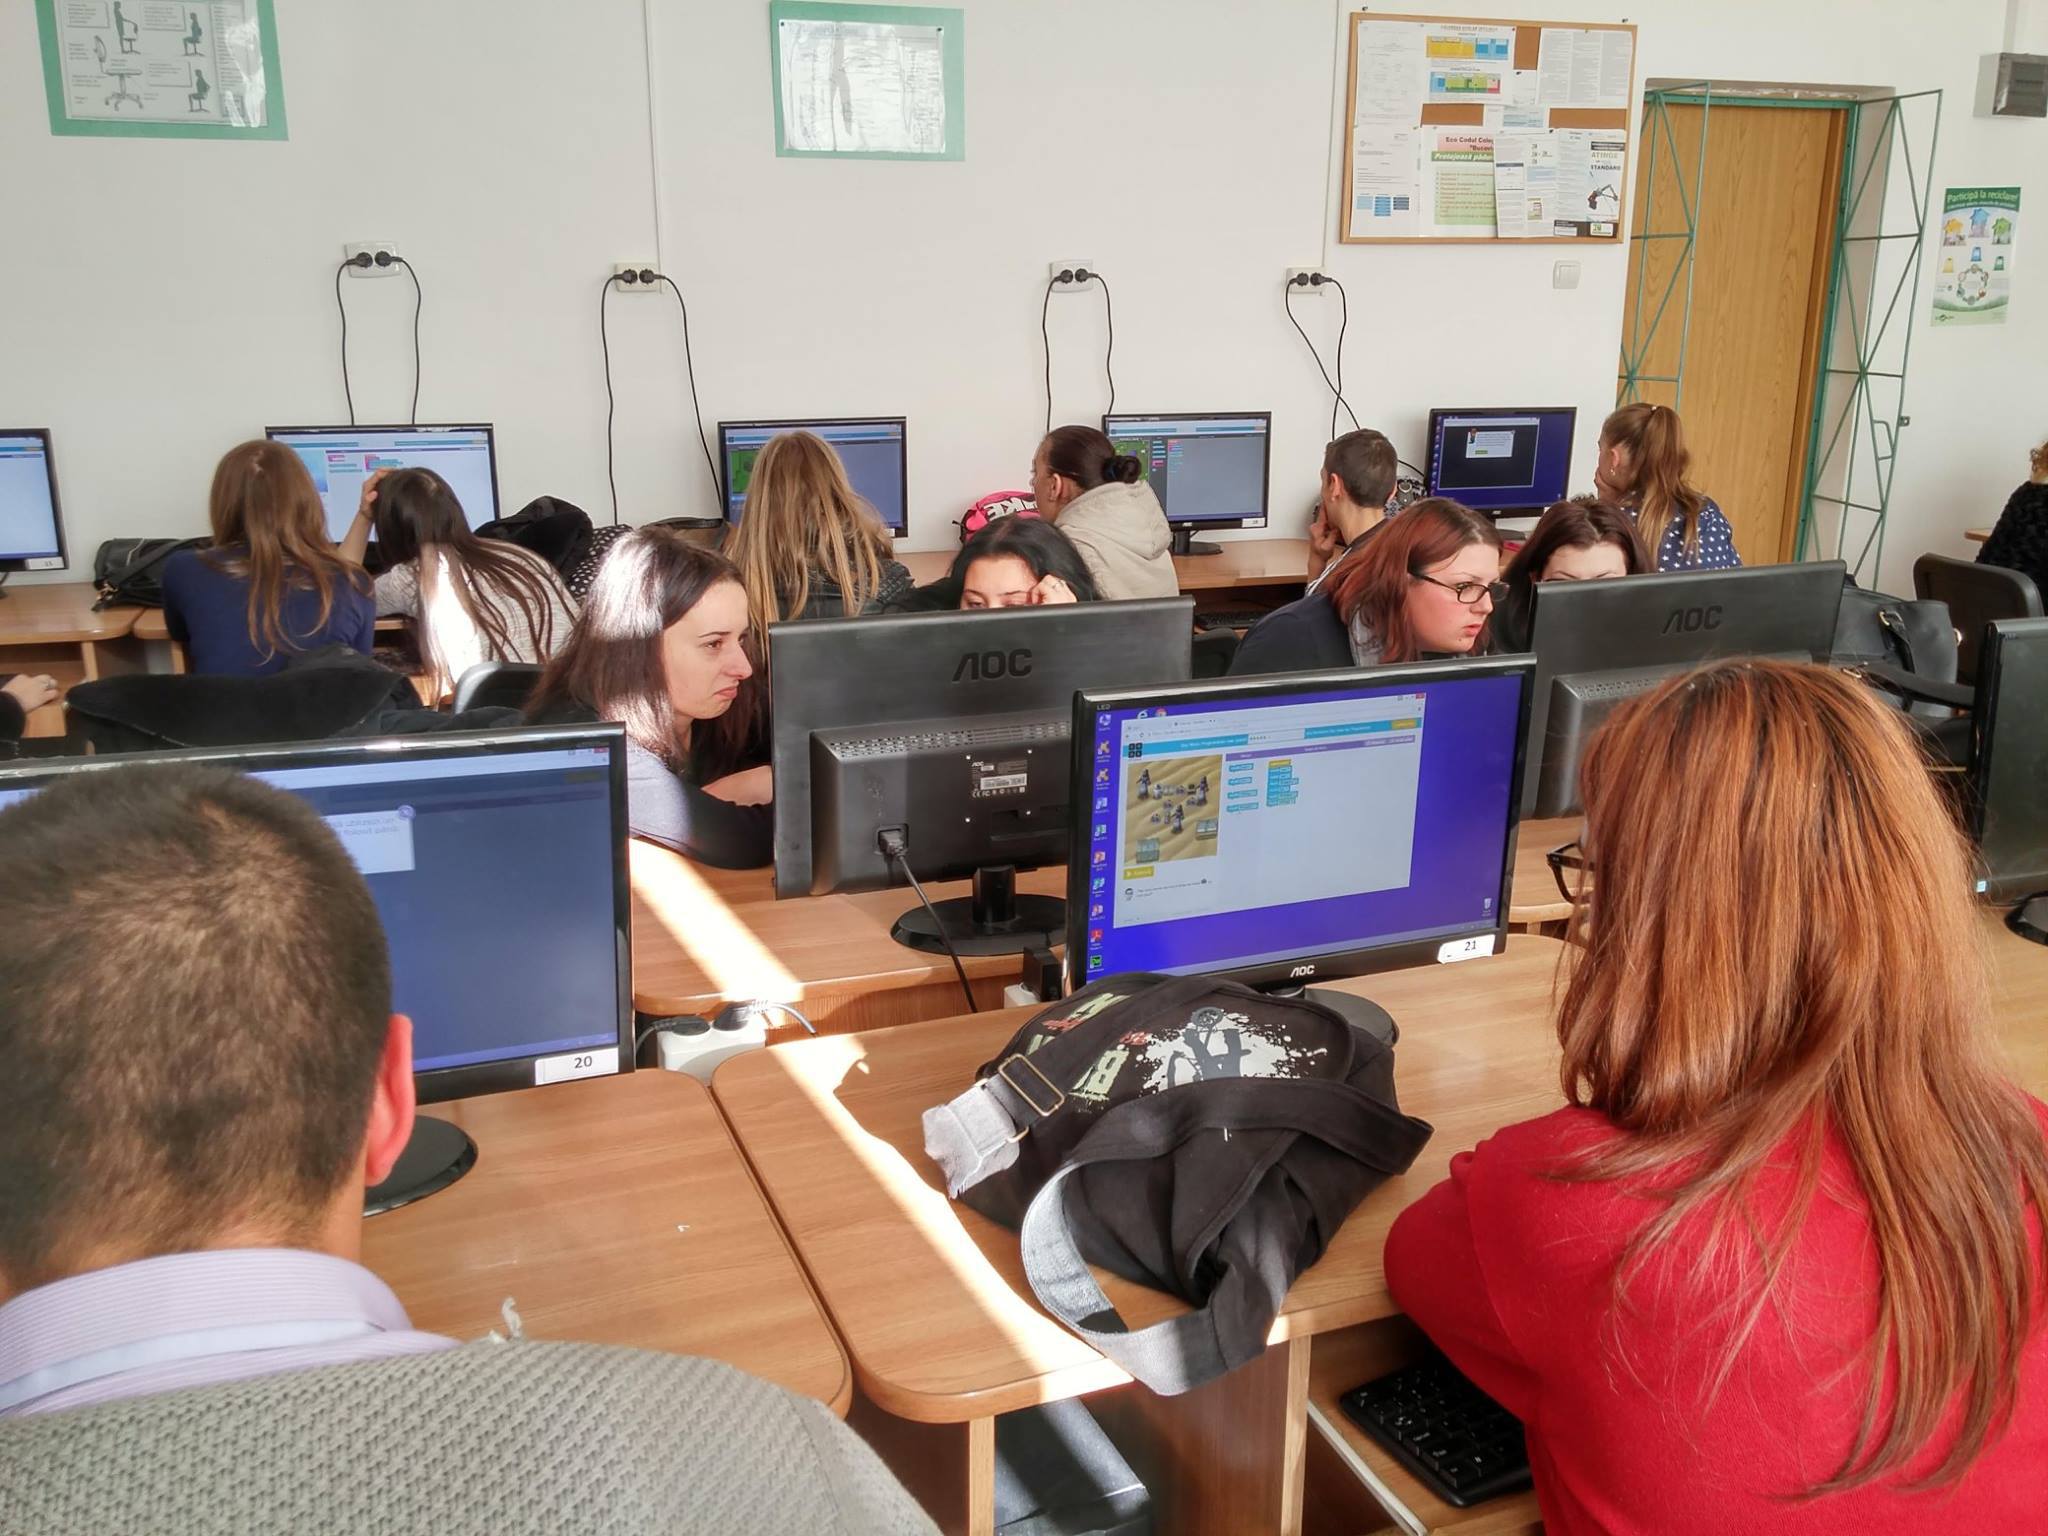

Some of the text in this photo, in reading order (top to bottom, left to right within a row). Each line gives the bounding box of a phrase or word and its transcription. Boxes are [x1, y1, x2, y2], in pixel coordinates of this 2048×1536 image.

[1662, 605, 1723, 634] AOC
[952, 648, 1033, 682] AOC
[1464, 940, 1477, 951] 21
[1290, 964, 1316, 978] AOC
[574, 1055, 593, 1069] 20
